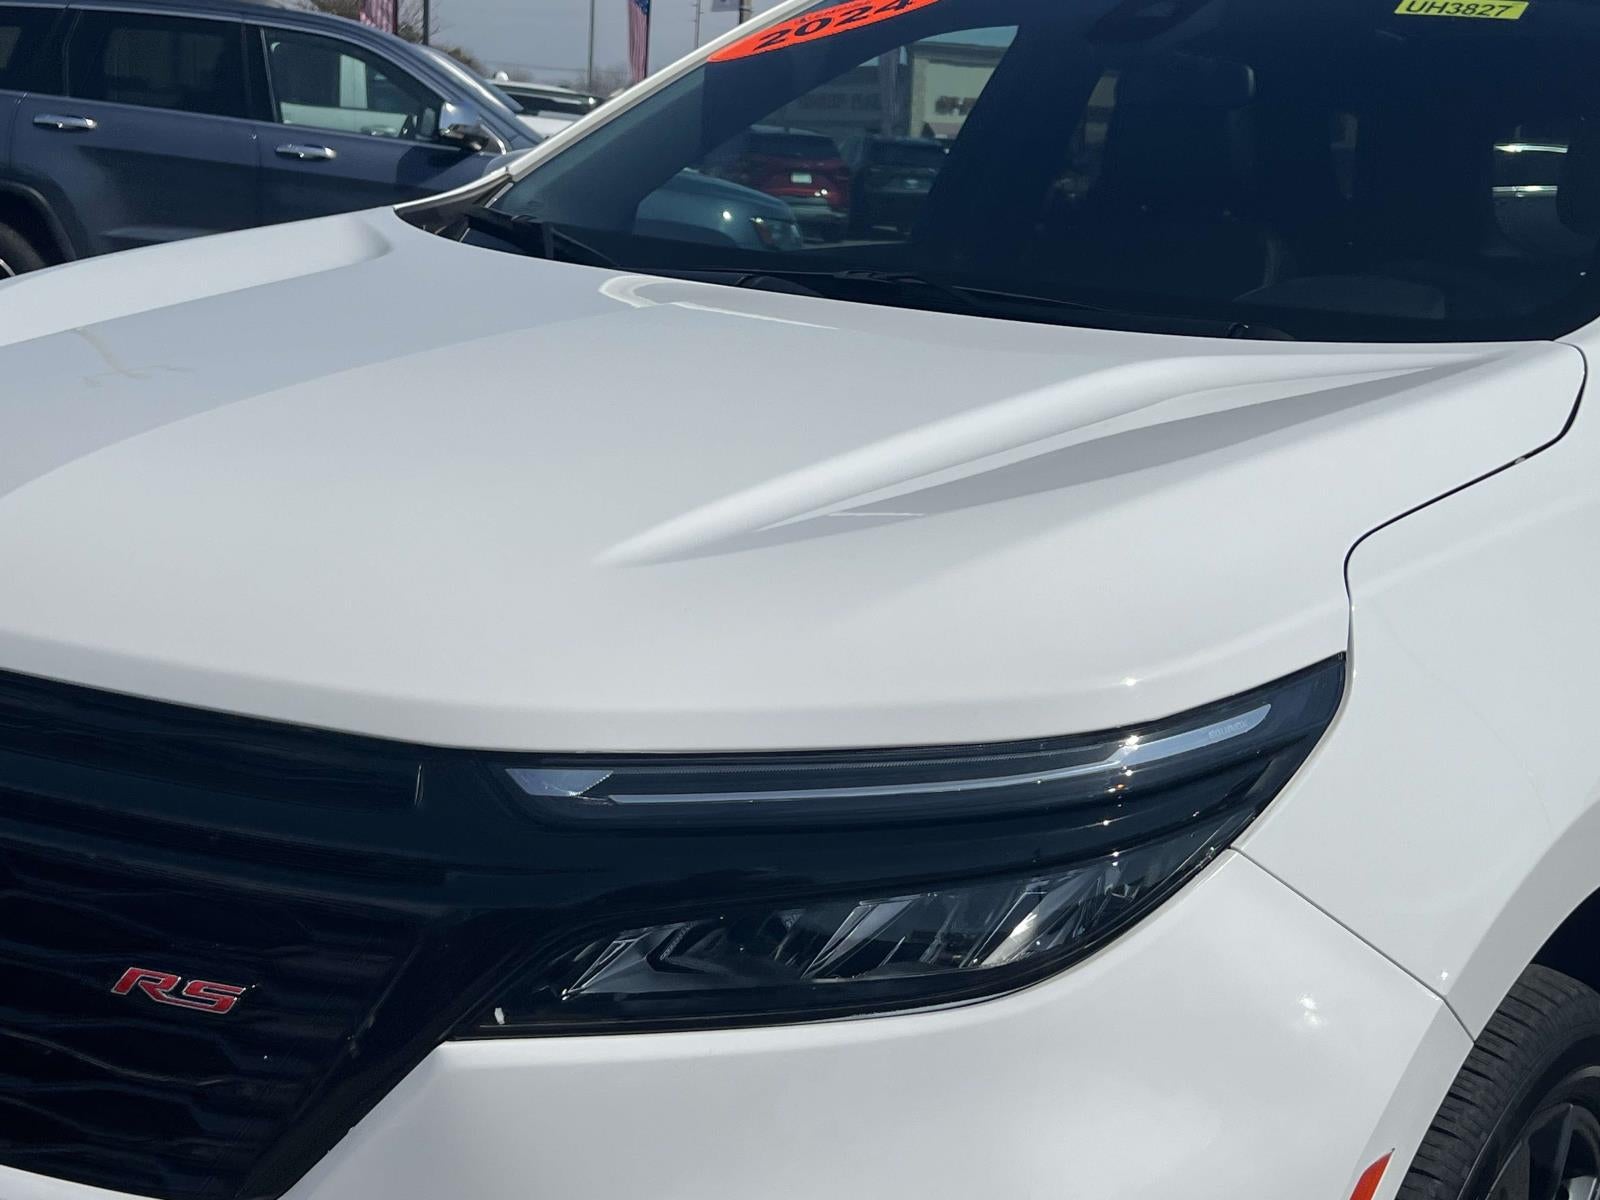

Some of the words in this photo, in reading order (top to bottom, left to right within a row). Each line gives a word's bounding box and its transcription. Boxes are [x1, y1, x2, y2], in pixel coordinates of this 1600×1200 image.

[753, 0, 912, 51] 2024
[1406, 0, 1512, 17] UH3827
[110, 967, 247, 1014] RS
